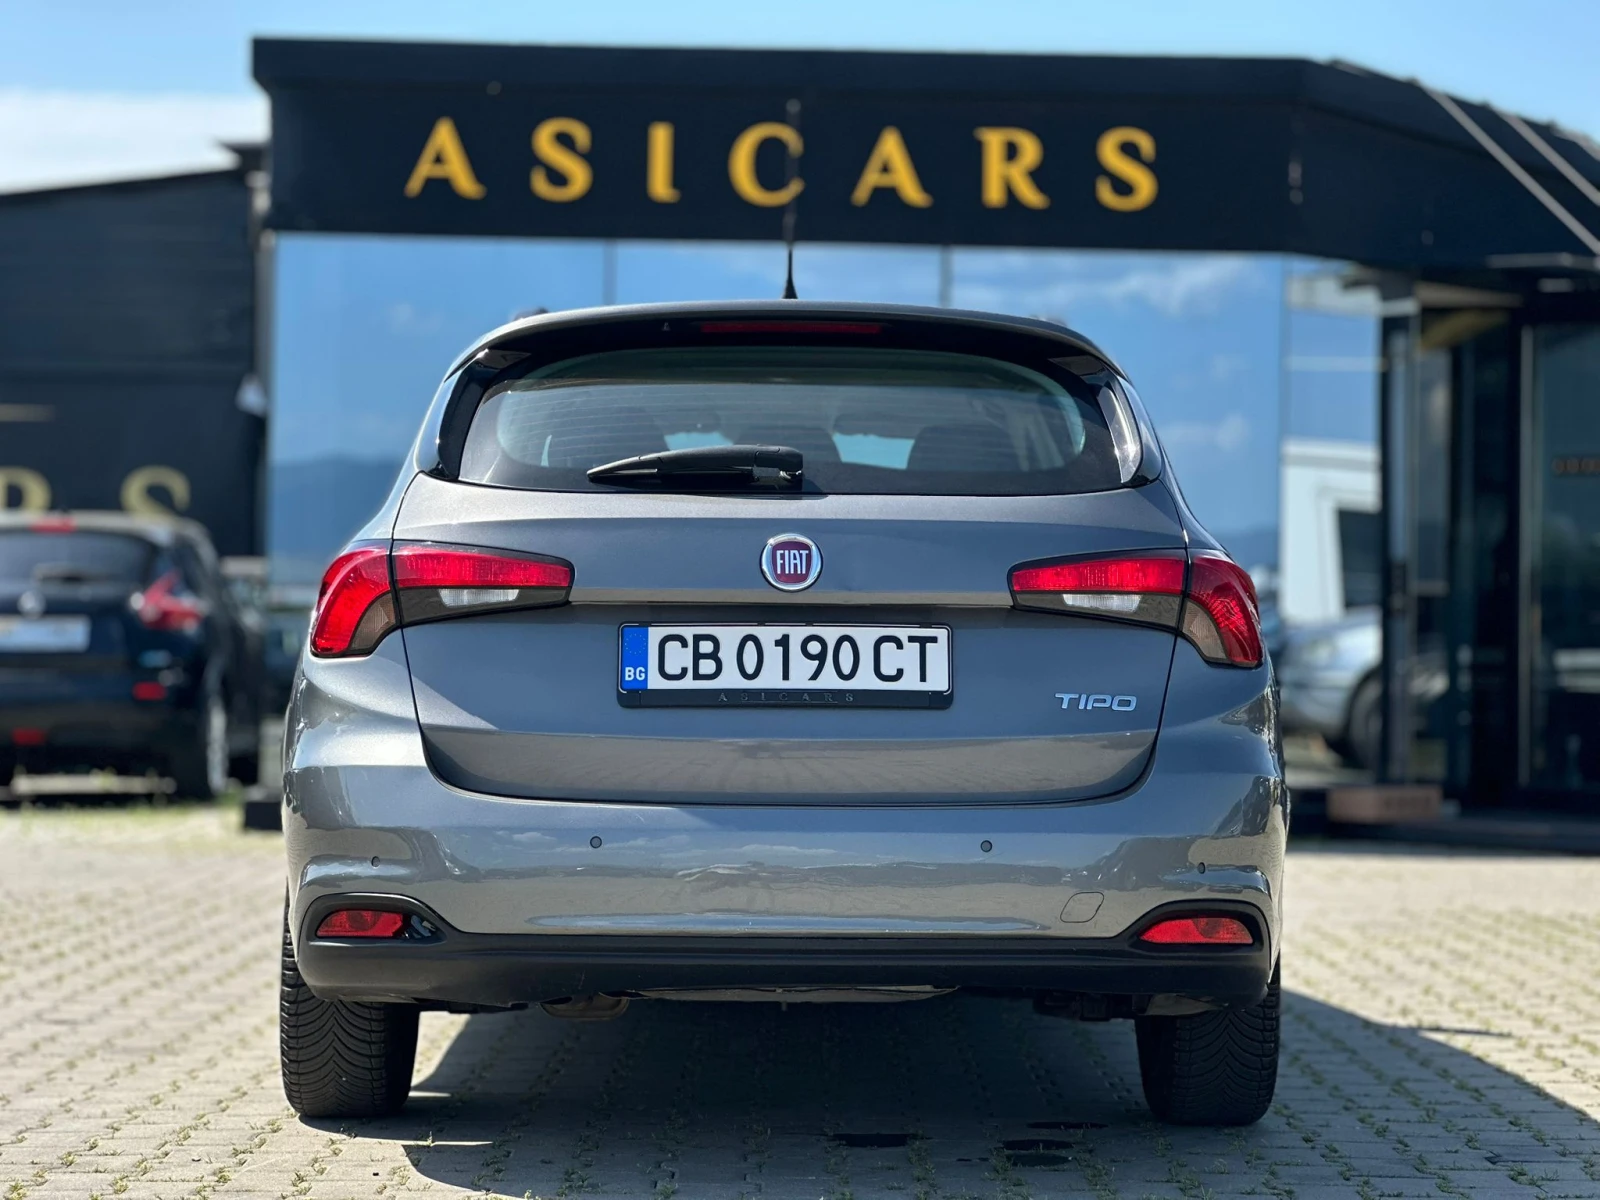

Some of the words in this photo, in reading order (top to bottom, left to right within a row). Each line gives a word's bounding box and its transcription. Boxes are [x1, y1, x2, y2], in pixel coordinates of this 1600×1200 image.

[404, 116, 1158, 212] ASICARS
[776, 550, 809, 574] FIAT
[658, 633, 723, 681] CB
[737, 633, 860, 681] 0190
[873, 634, 938, 682] CT
[624, 667, 645, 681] BG
[718, 692, 854, 702] ASICARS
[1055, 693, 1137, 711] TIPO
